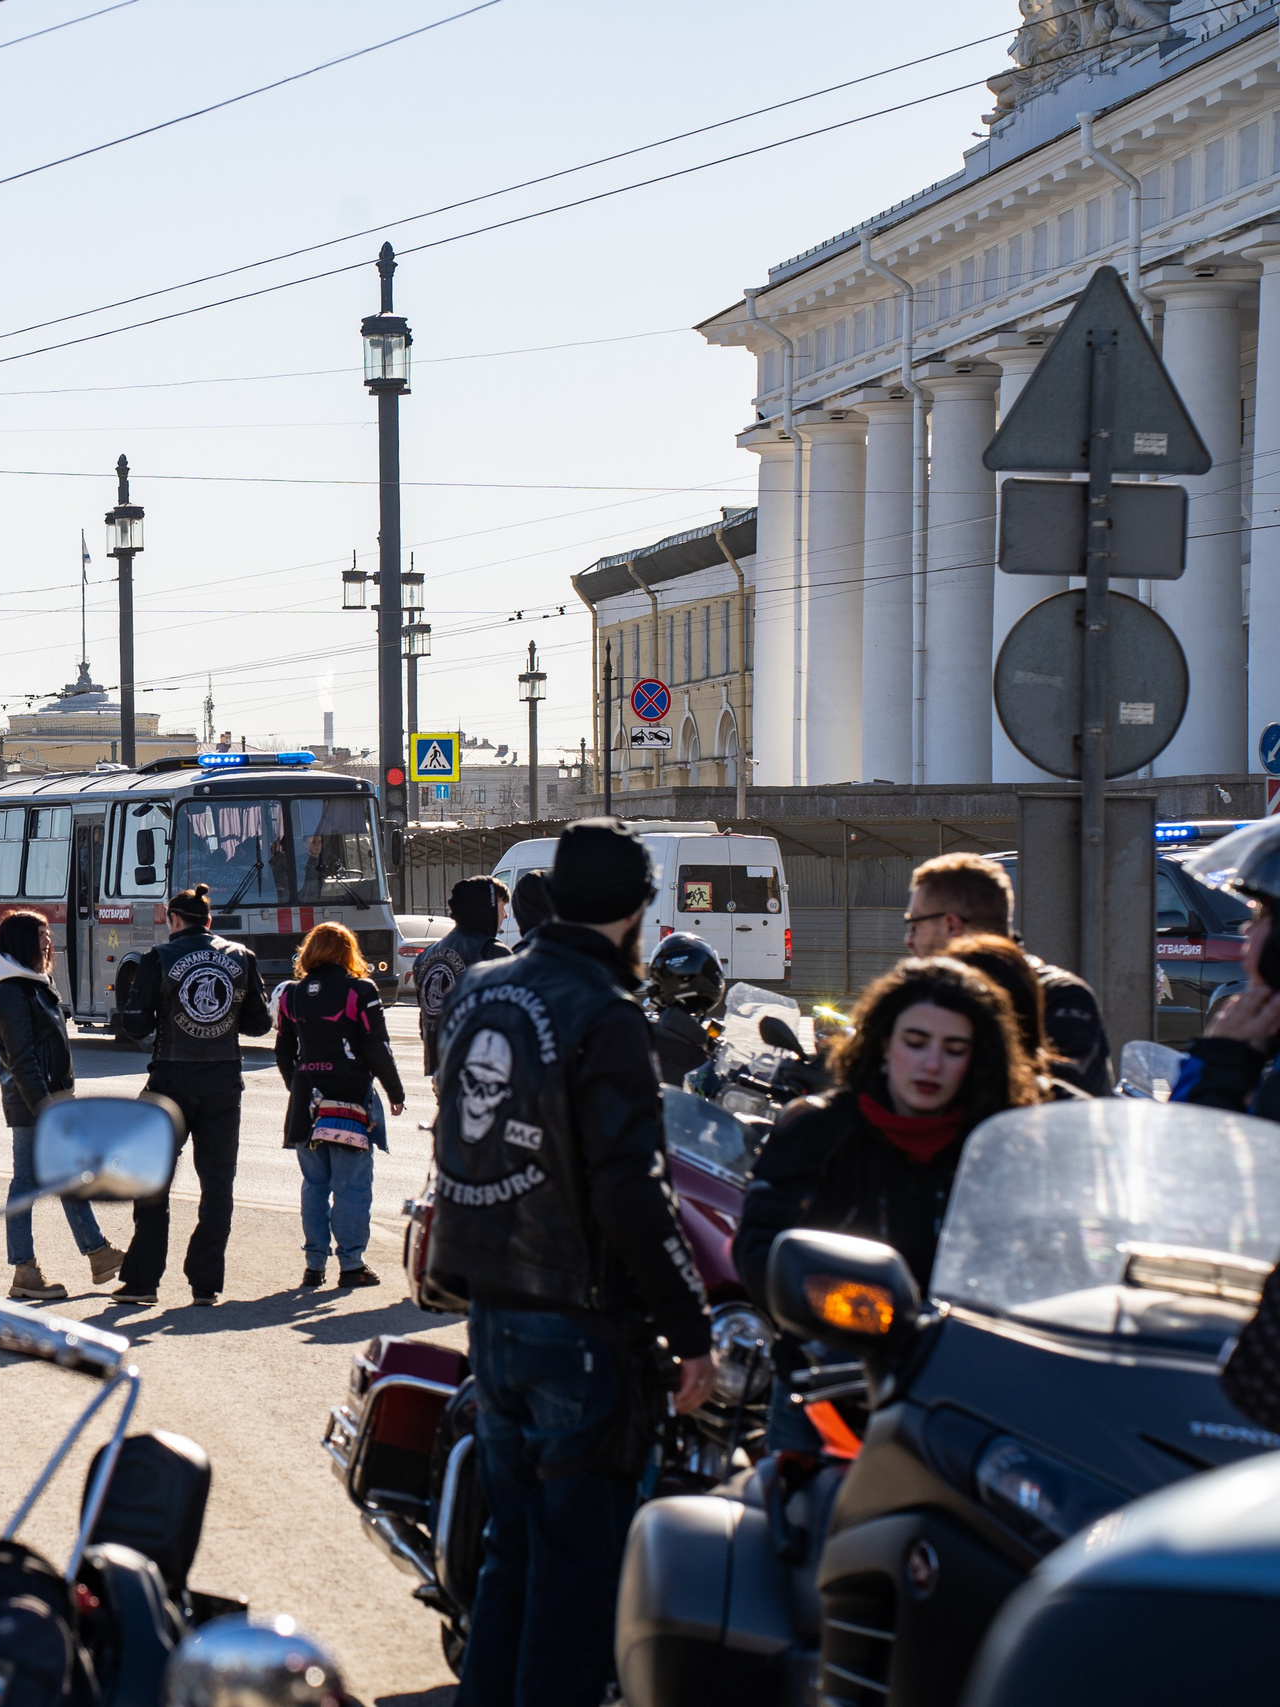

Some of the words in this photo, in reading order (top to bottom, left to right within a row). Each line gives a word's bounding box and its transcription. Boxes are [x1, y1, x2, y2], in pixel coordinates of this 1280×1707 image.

[770, 901, 777, 909] 60
[99, 909, 130, 920] РОСГВАРДИЯ
[1157, 944, 1201, 955] СГВАРДИЯ
[171, 951, 210, 977] NORMANS
[481, 983, 558, 1065] HOOLIGANS
[299, 1062, 334, 1071] MOTEQ
[509, 1125, 540, 1147] MC
[1190, 1421, 1280, 1447] HOND
